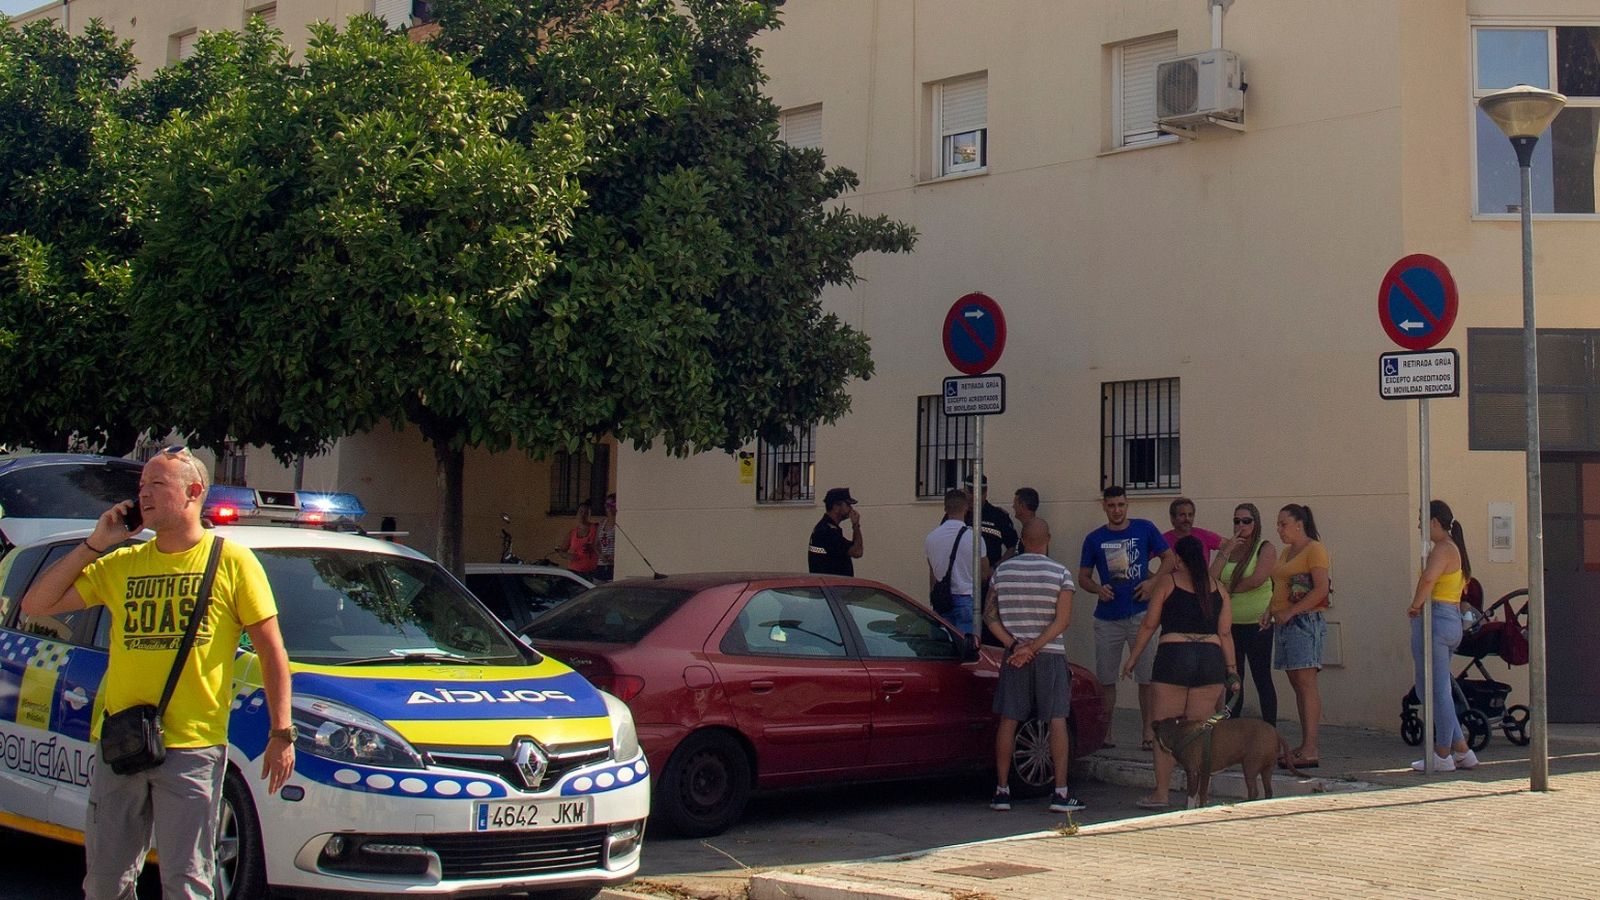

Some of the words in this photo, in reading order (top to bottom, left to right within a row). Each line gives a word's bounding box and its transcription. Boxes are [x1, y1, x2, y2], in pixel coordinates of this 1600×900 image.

[1402, 359, 1433, 368] RETIRADA
[1434, 357, 1452, 366] GRÚA
[1385, 376, 1411, 384] EXCEPTO
[1412, 374, 1451, 382] ACREDITADOS
[1393, 385, 1423, 393] MOVILIDAD
[1424, 384, 1453, 392] REDUCIDA
[126, 578, 176, 599] SOUTH
[492, 805, 538, 827] 4642
[552, 802, 584, 824] JKM
